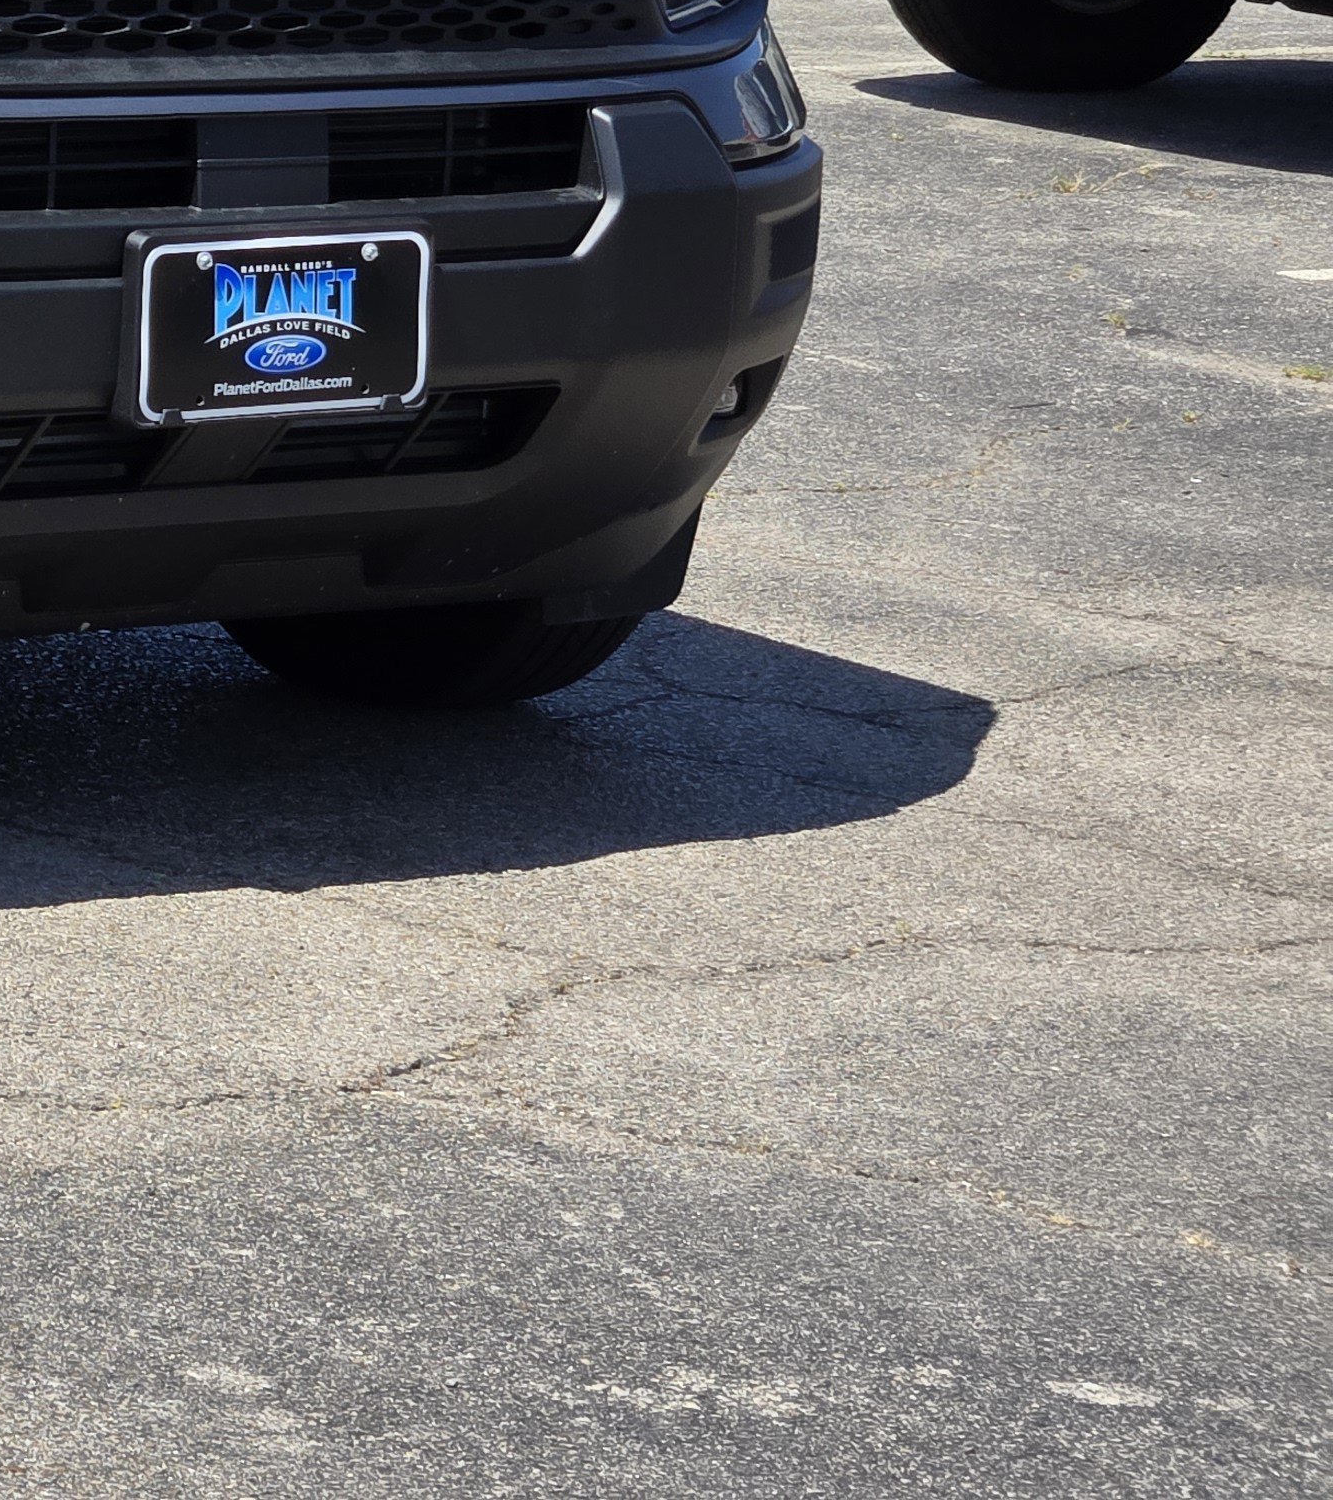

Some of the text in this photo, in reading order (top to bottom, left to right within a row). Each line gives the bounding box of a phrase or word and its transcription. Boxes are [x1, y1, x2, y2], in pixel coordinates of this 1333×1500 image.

[214, 263, 357, 336] PLANET
[220, 321, 351, 349] DALLAS LOVE FIELD
[259, 341, 312, 368] Ford
[213, 376, 353, 397] PlanetFordDallas.com
